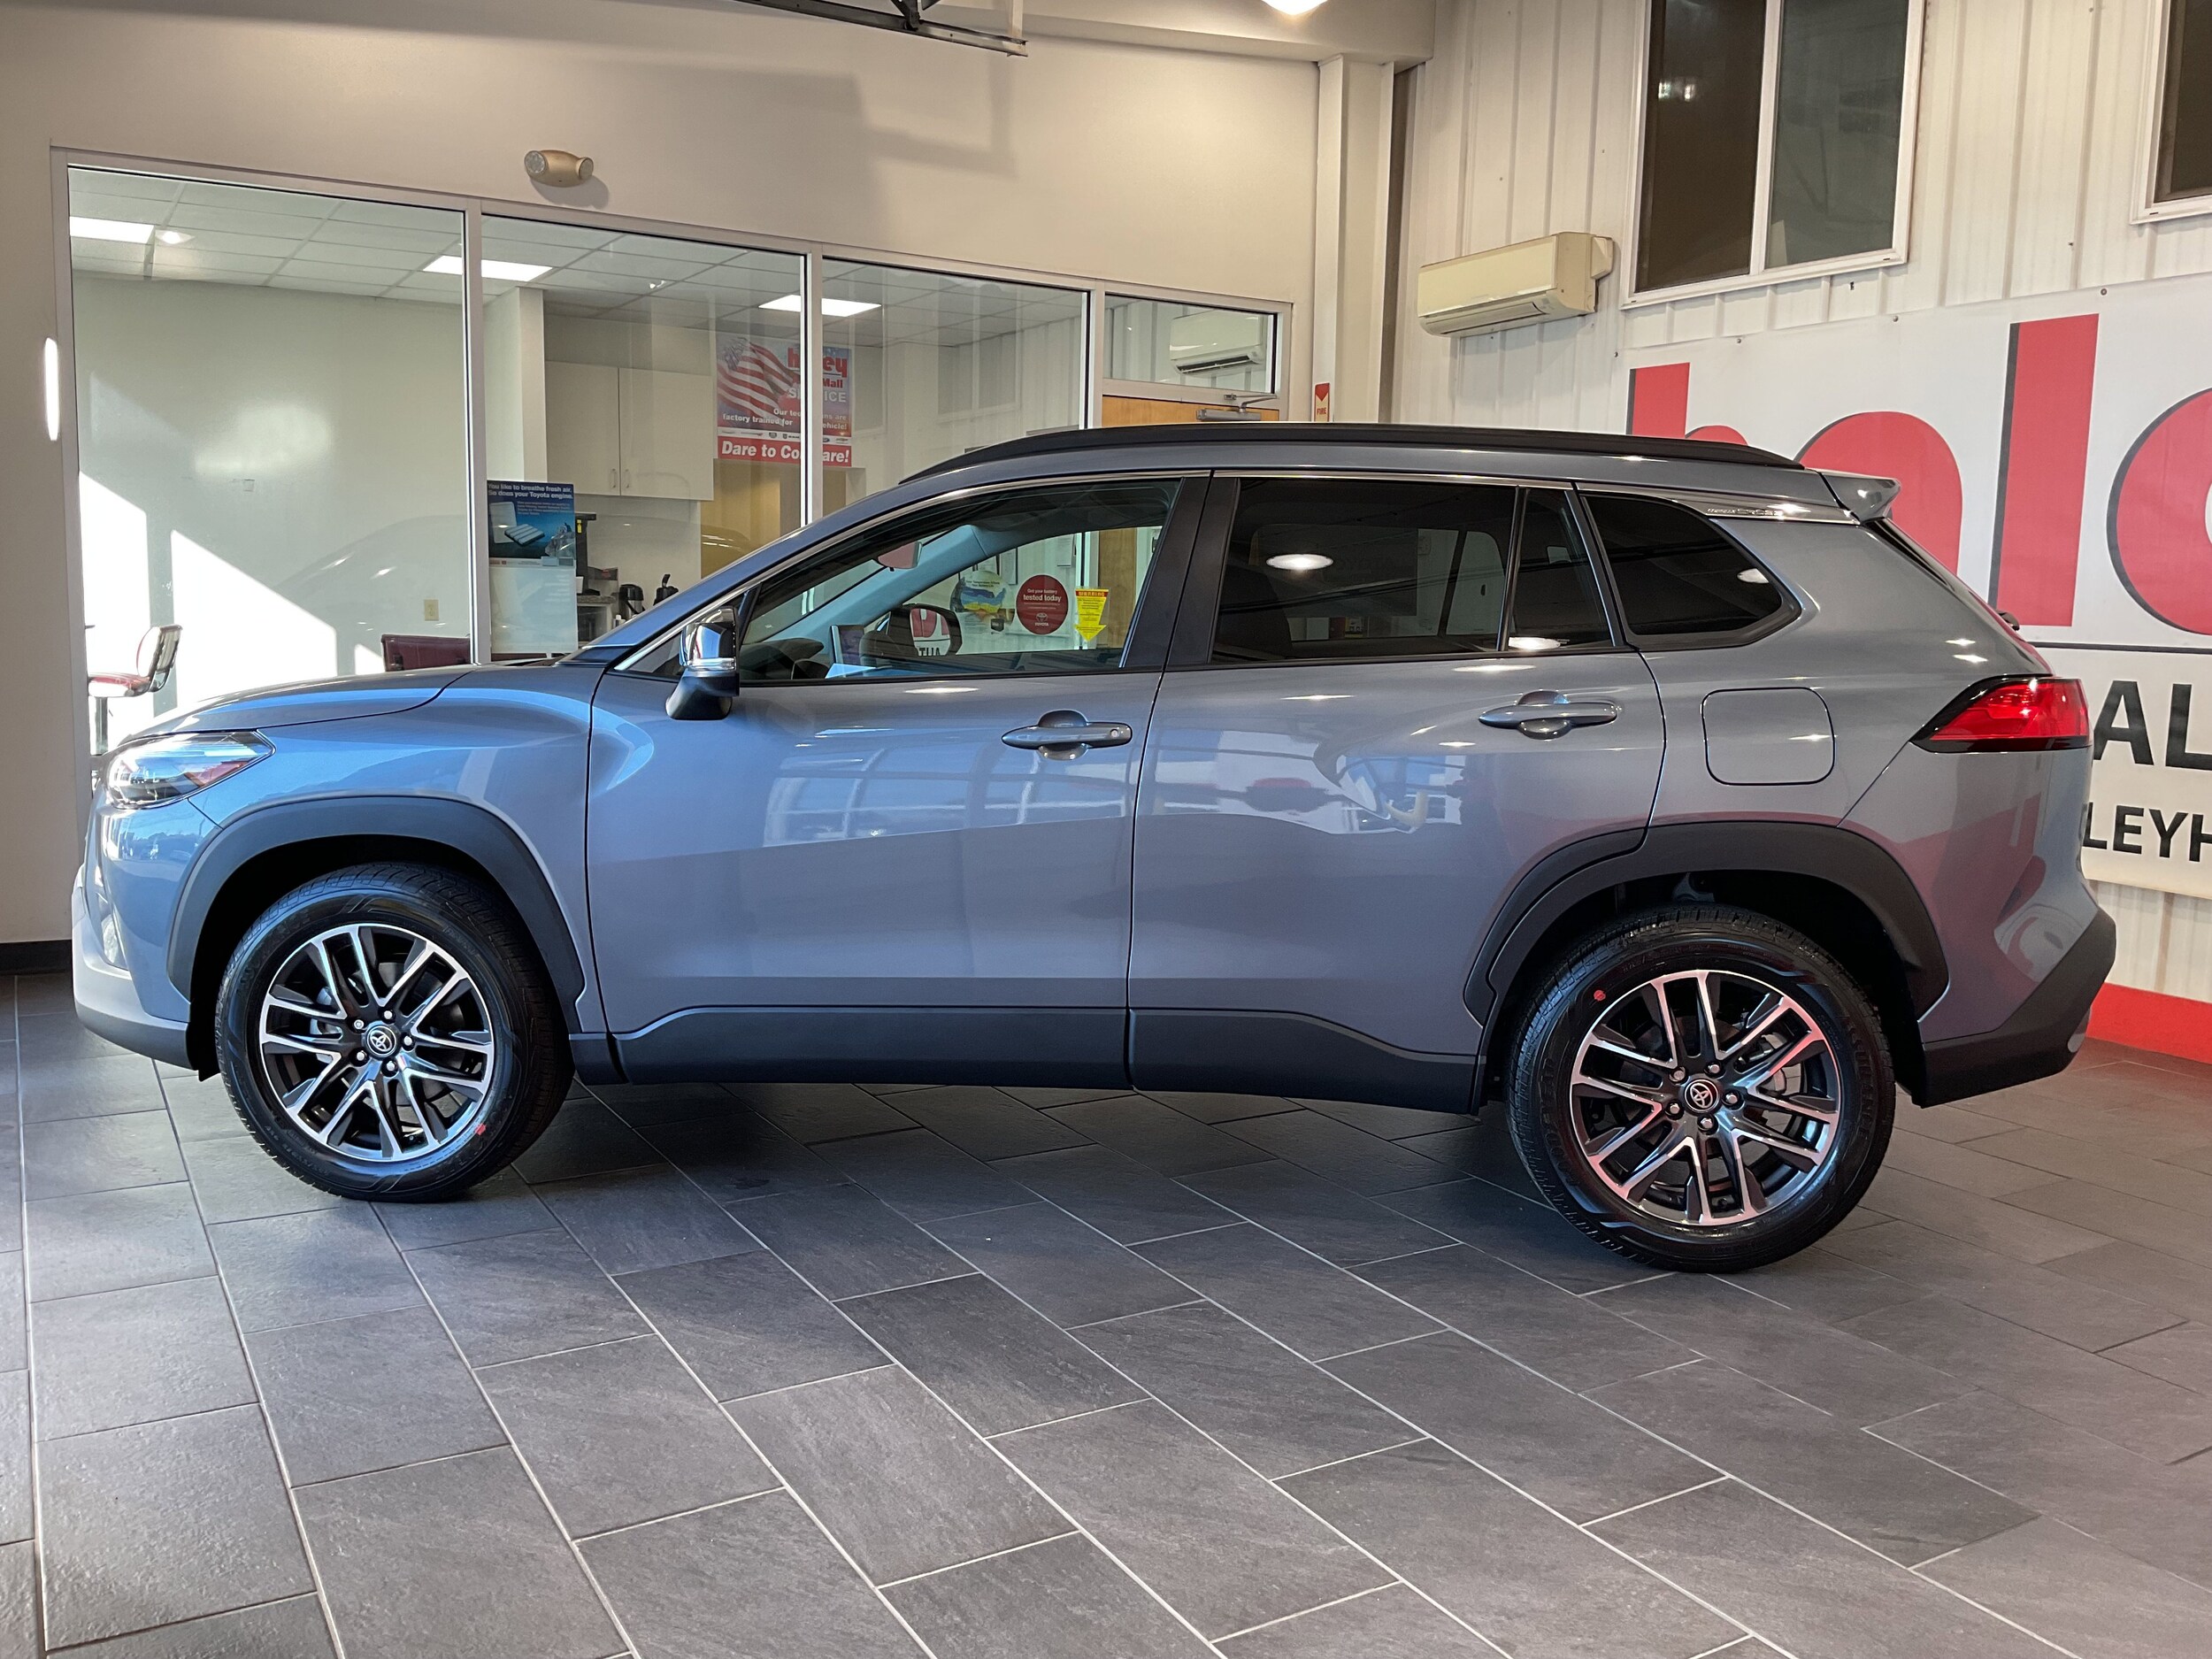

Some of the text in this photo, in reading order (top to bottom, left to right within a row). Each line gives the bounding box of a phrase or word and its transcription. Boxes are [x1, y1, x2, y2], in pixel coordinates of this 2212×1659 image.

[723, 413, 750, 424] factory
[722, 441, 849, 463] Dare to Coare!
